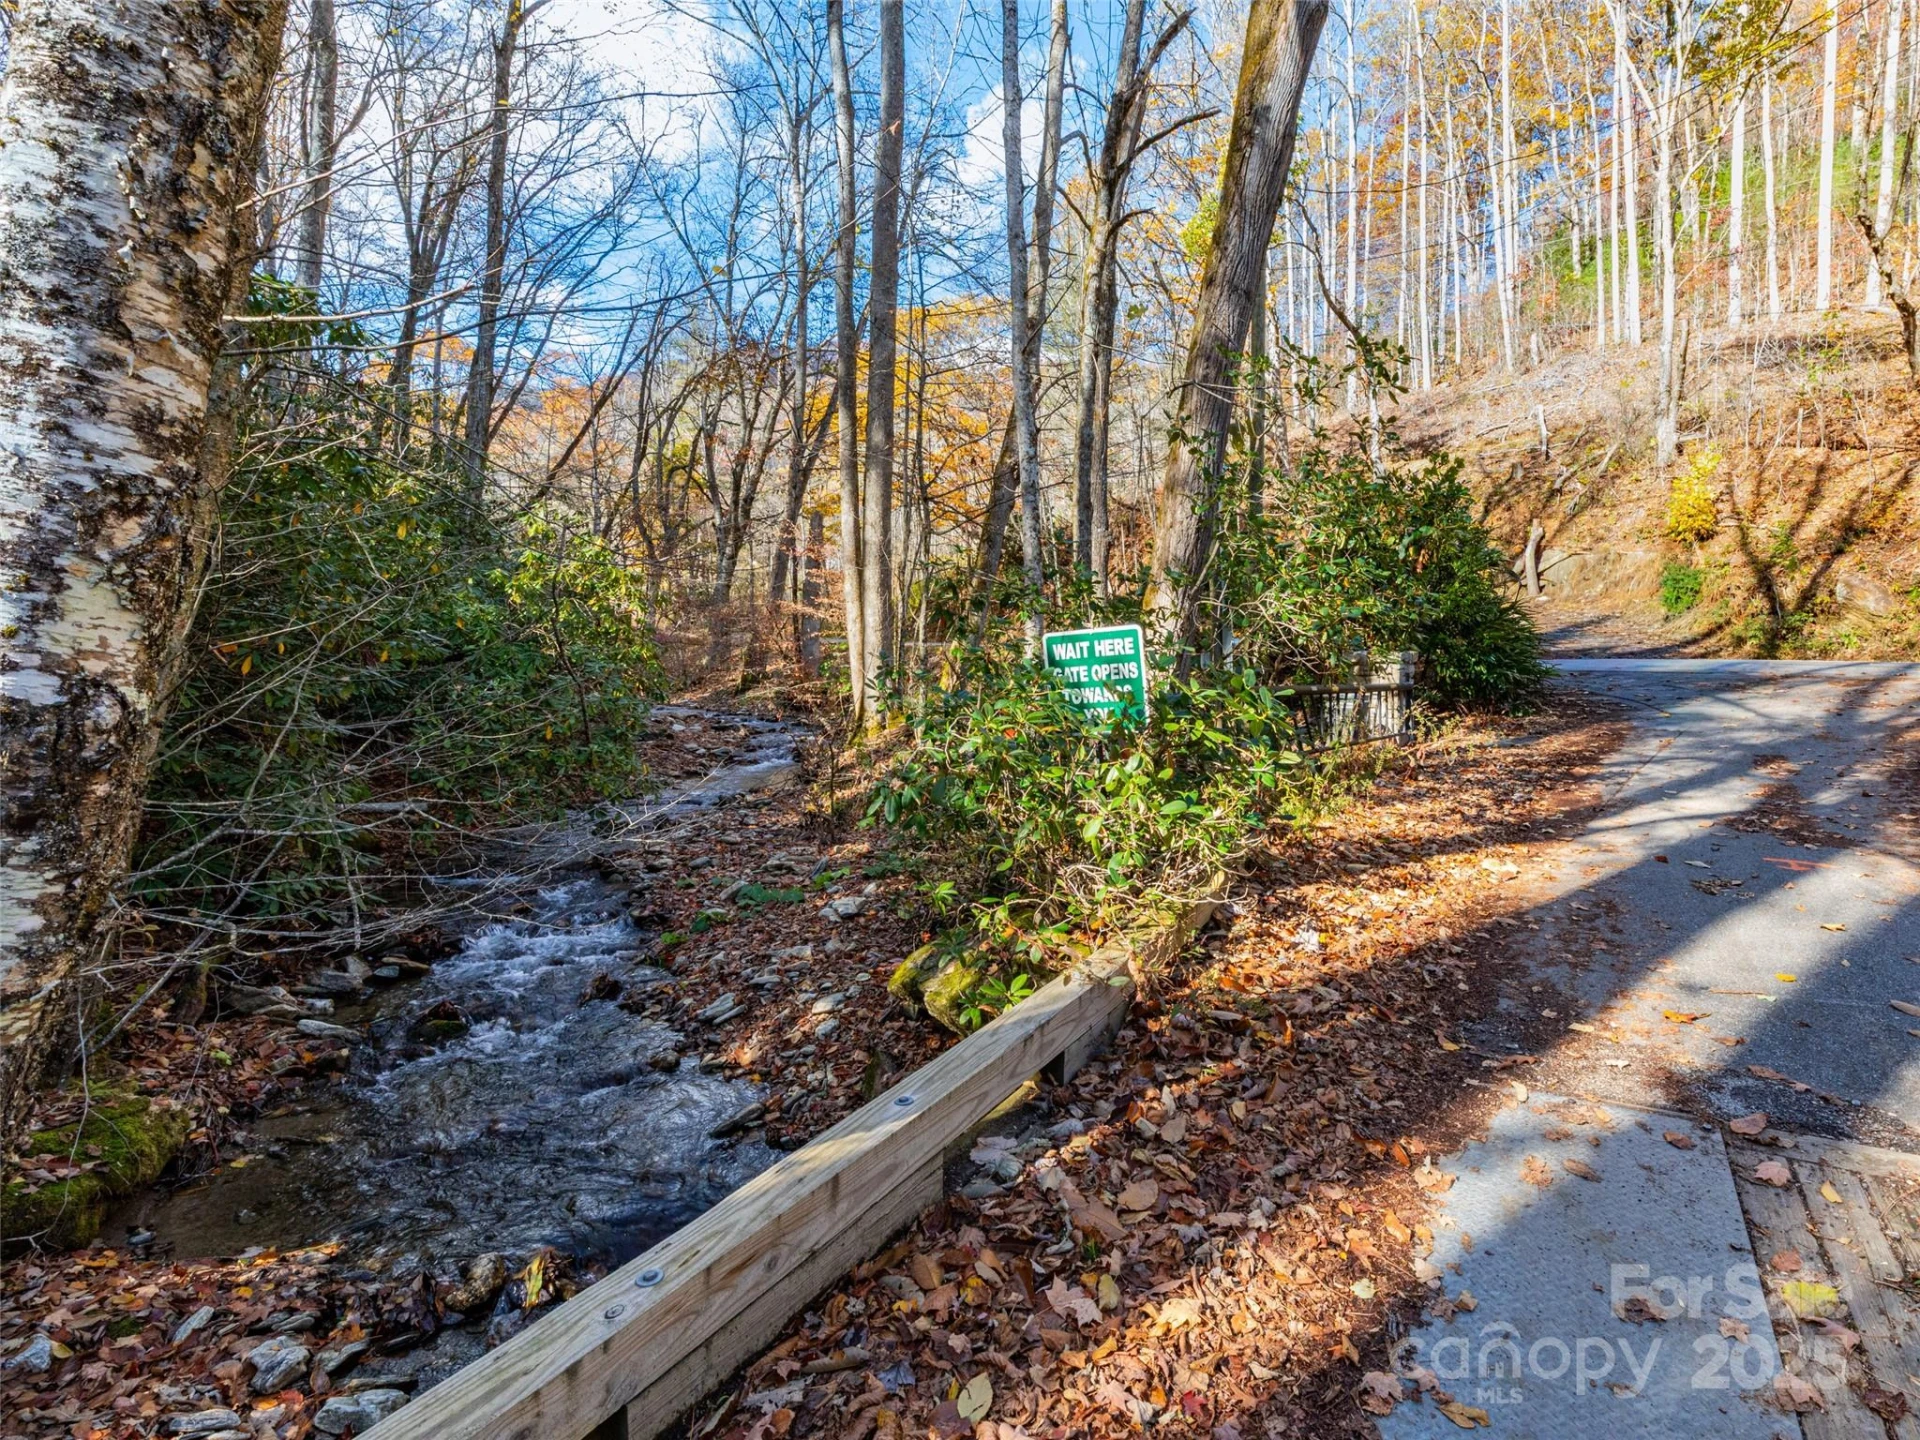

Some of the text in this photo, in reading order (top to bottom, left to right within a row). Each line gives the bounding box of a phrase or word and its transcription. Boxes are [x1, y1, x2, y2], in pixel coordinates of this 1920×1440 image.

[1052, 637, 1134, 660] WAIT HERE
[1091, 662, 1138, 682] OPENS
